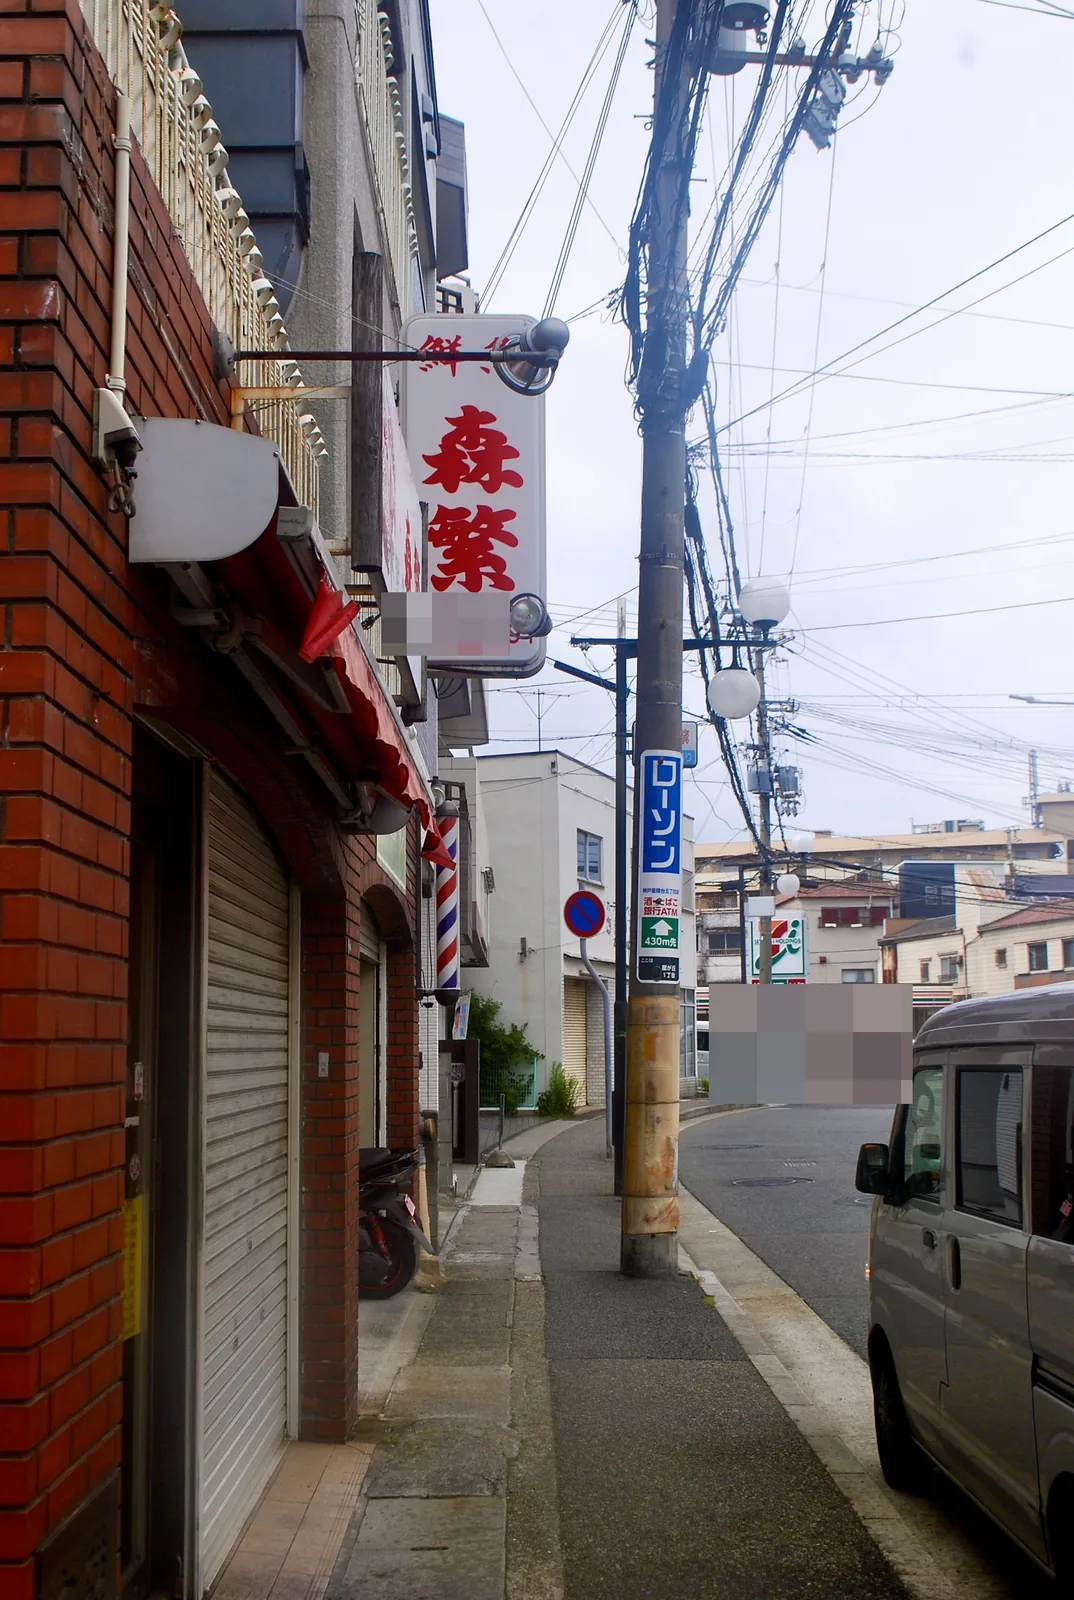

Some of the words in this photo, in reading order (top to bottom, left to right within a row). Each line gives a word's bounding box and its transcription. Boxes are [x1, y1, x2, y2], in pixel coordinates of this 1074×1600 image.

[421, 405, 524, 592] 森繁
[650, 759, 677, 869] ローソン
[643, 906, 678, 916] 銀行ATM
[644, 936, 677, 947] 430m先
